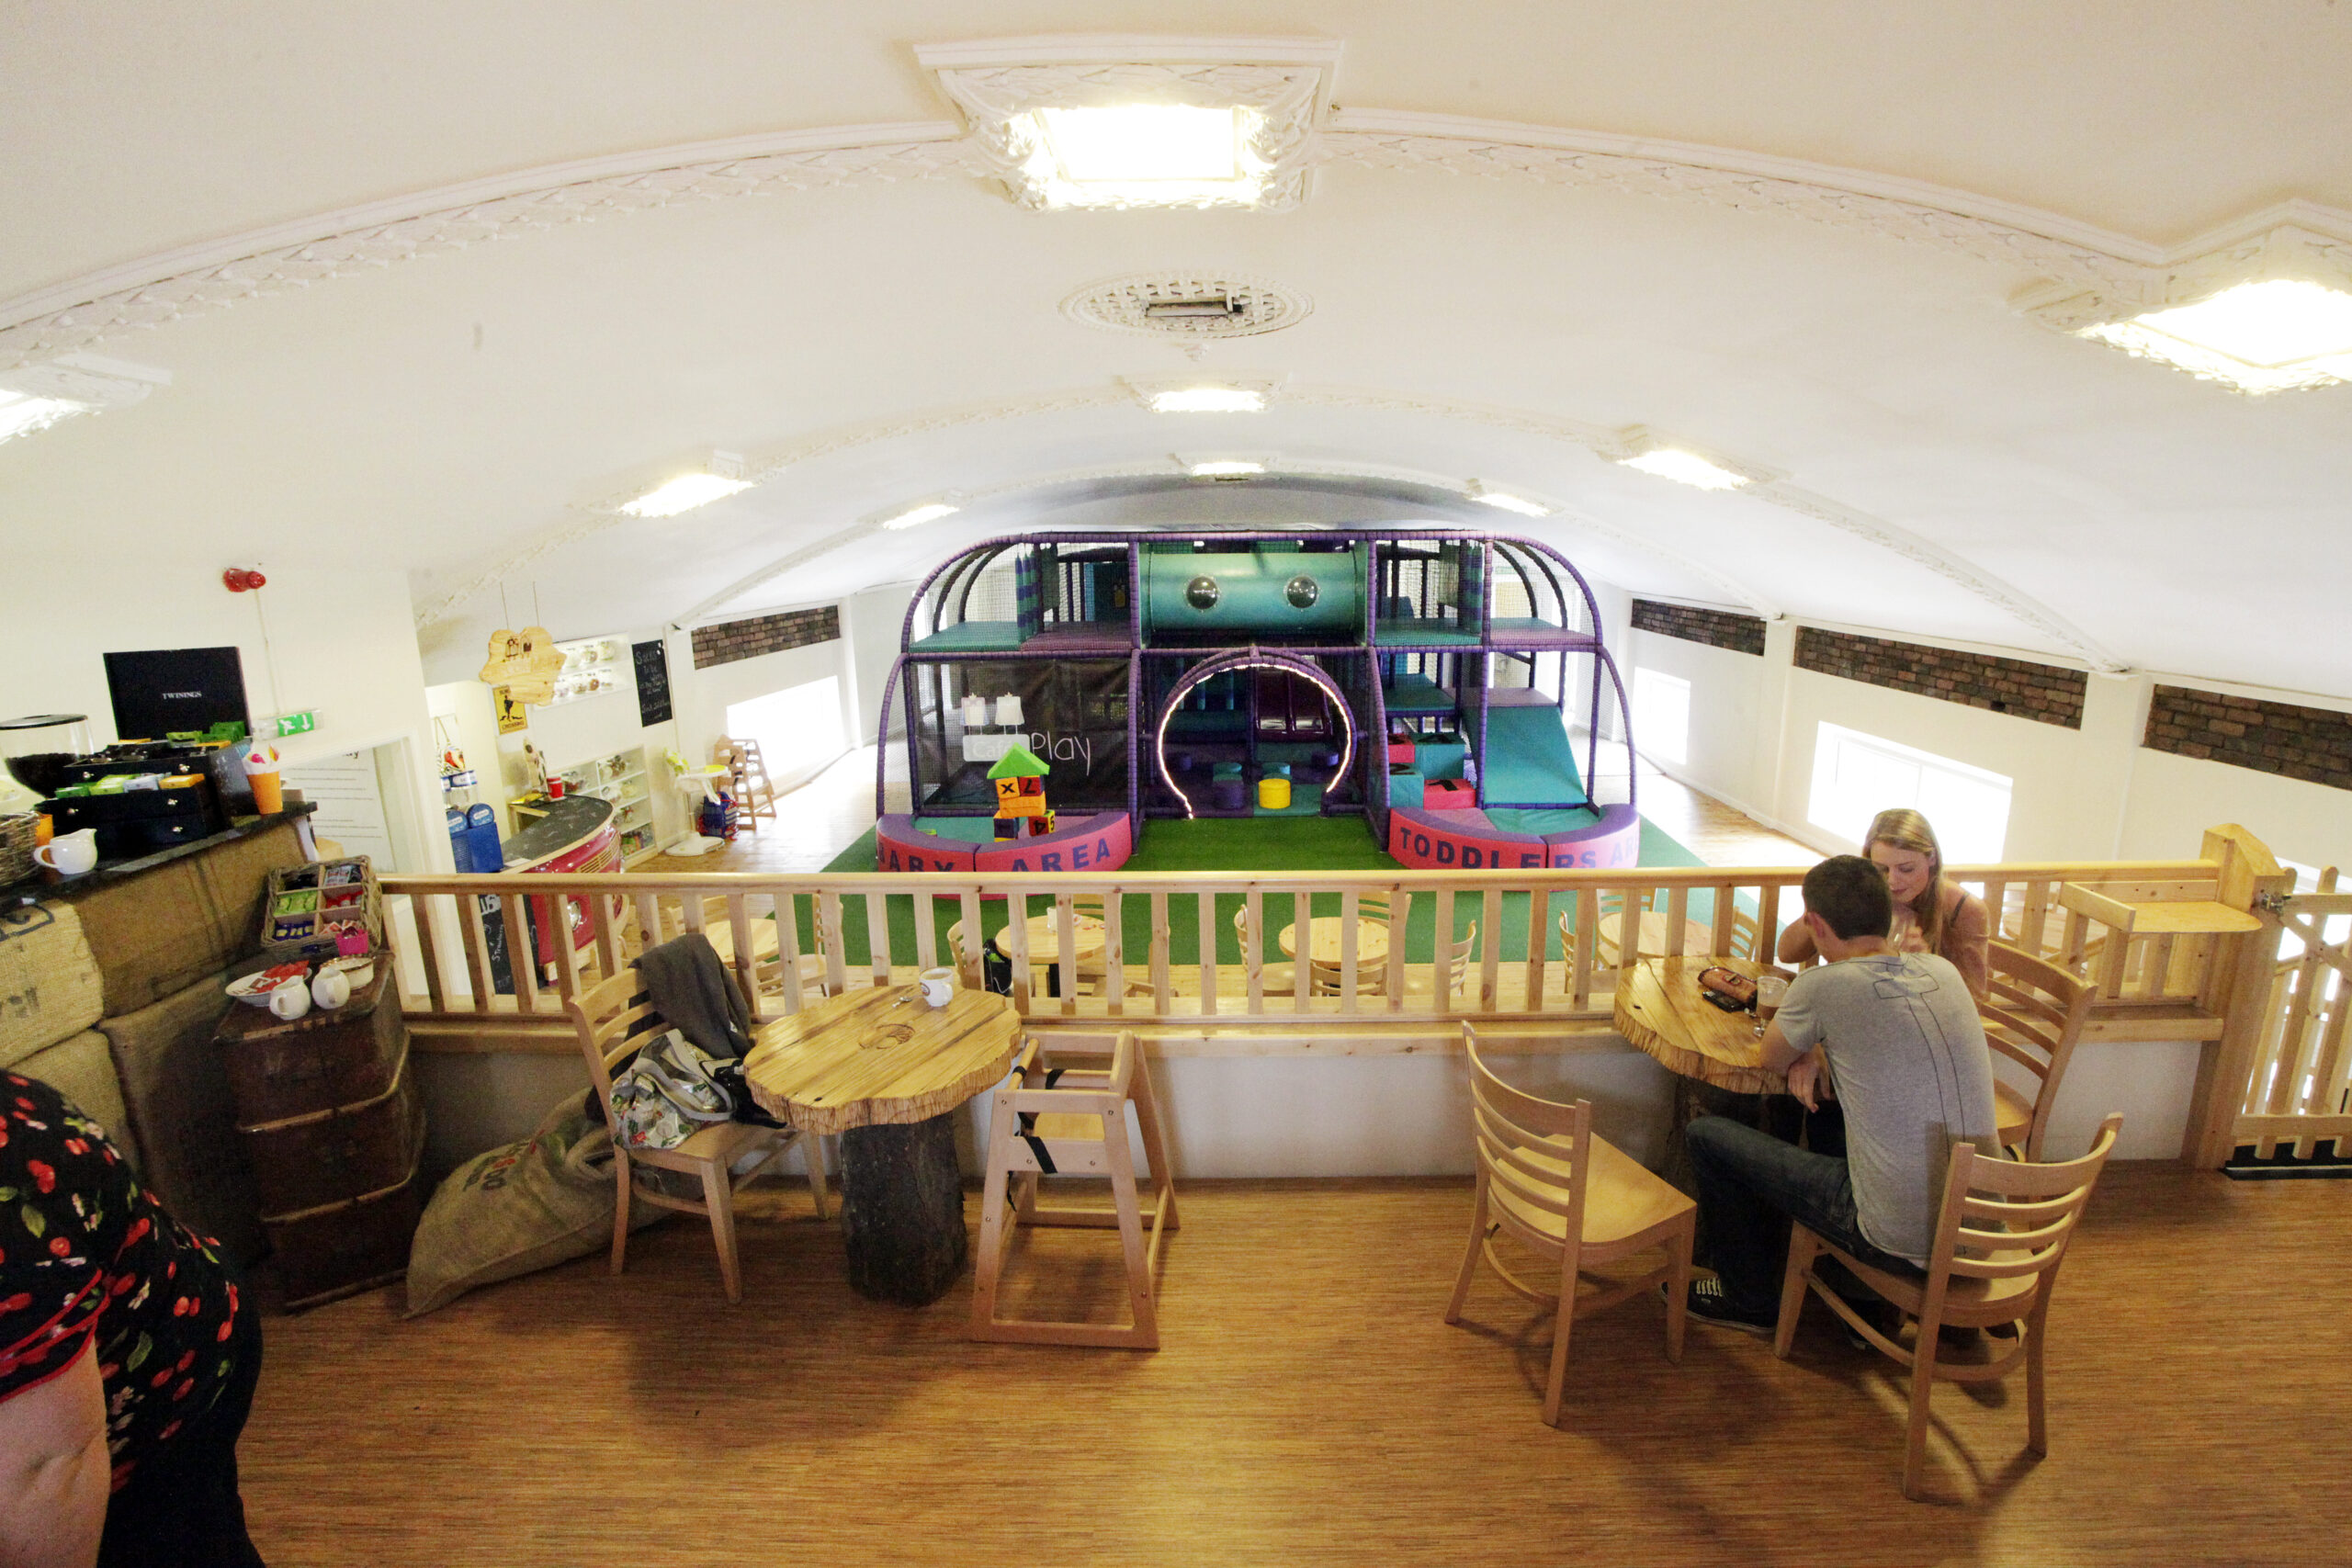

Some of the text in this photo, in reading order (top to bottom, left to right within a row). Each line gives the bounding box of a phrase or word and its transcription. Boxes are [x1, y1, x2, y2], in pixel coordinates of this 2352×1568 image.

[162, 691, 202, 700] TWININGS
[1031, 730, 1091, 776] Play
[1012, 838, 1111, 872] AREA
[1610, 834, 1639, 867] AR
